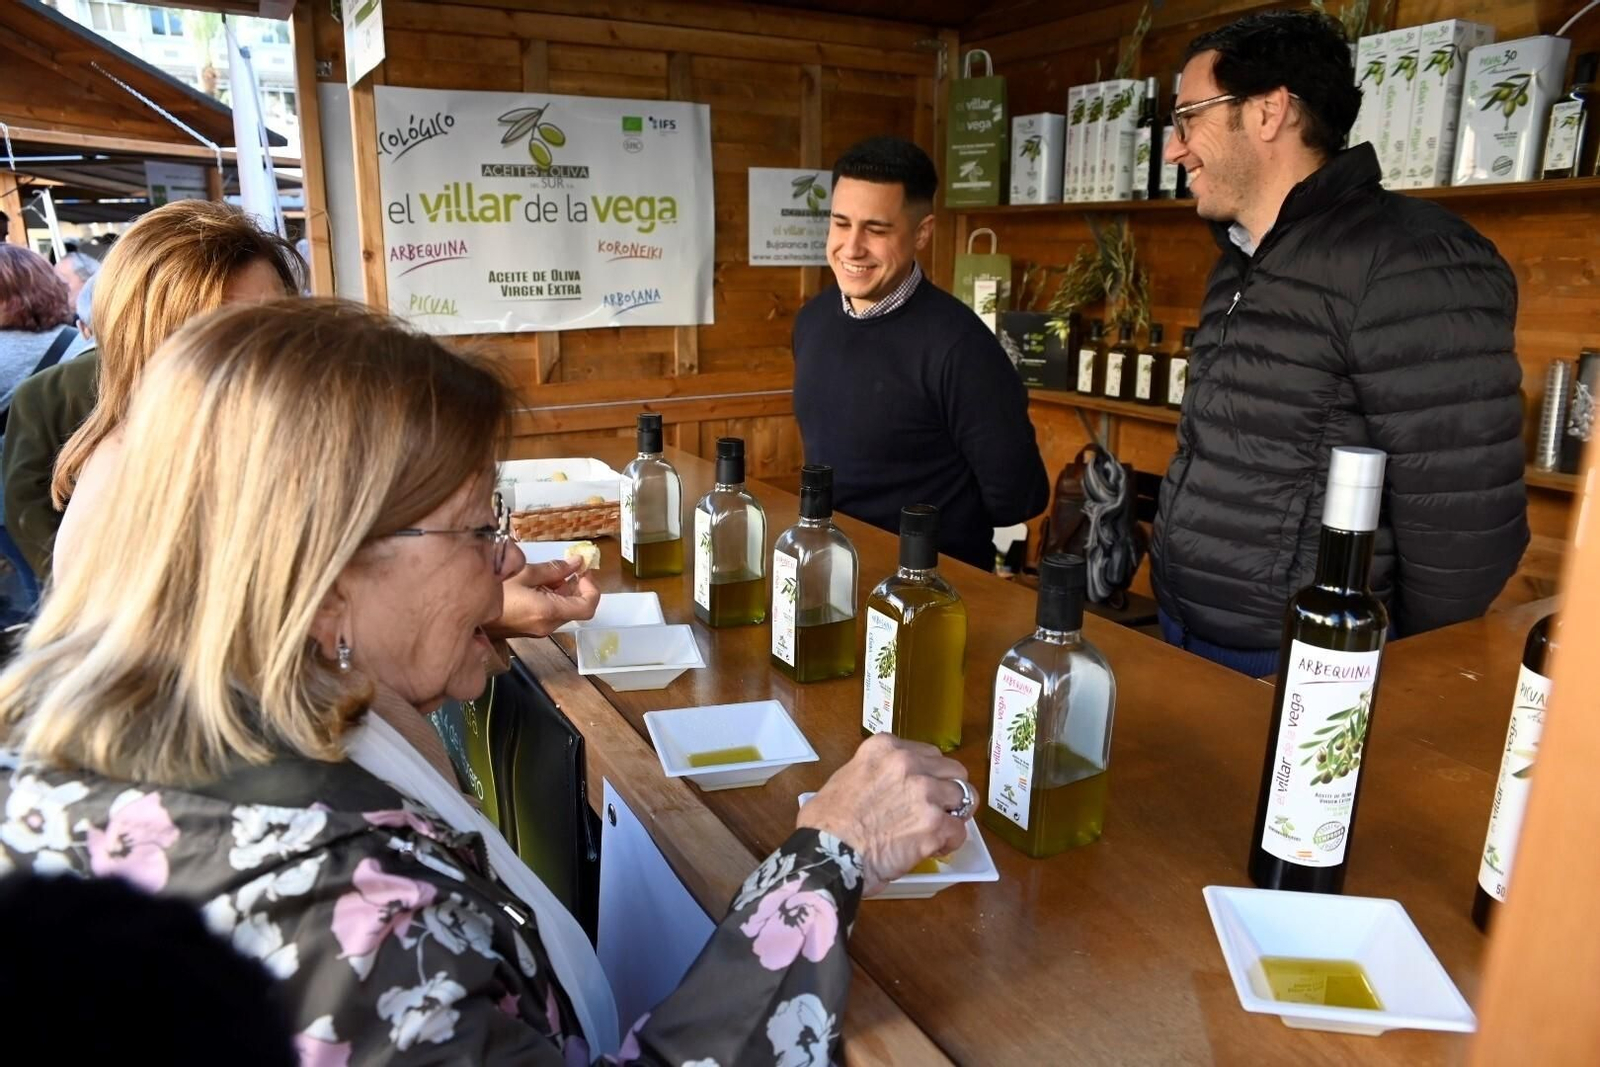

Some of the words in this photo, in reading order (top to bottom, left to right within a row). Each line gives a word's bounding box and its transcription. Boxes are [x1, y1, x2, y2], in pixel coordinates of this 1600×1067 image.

[1503, 49, 1517, 66] 30
[966, 97, 993, 111] villar
[377, 112, 455, 155] COLÓGICO
[659, 119, 677, 129] IFS
[967, 119, 992, 133] vega
[483, 165, 539, 177] ACEITES
[550, 166, 588, 178] OLIVA
[541, 177, 564, 189] SUR
[388, 194, 414, 224] el
[419, 182, 522, 223] villar
[525, 194, 558, 223] de
[567, 194, 588, 223] la
[591, 195, 677, 233] vega
[390, 240, 468, 262] ARBEQUINA
[598, 239, 663, 260] KORONEIKI
[488, 270, 530, 283] ACEITE
[533, 271, 548, 282] DE
[551, 269, 581, 282] OLIVA
[501, 284, 545, 297] VIRGEN
[548, 283, 582, 296] EXTRA
[603, 289, 660, 308] ARBOSANA
[410, 294, 458, 315] PICUAL
[1298, 657, 1371, 680] ARBEQUINA
[1287, 692, 1305, 728] vega
[994, 741, 1002, 766] villar
[998, 696, 1007, 721] vega
[1288, 729, 1297, 742] la
[1282, 743, 1294, 757] de
[1277, 756, 1292, 793] villar
[1492, 783, 1504, 820] villar
[1505, 717, 1518, 753] vega
